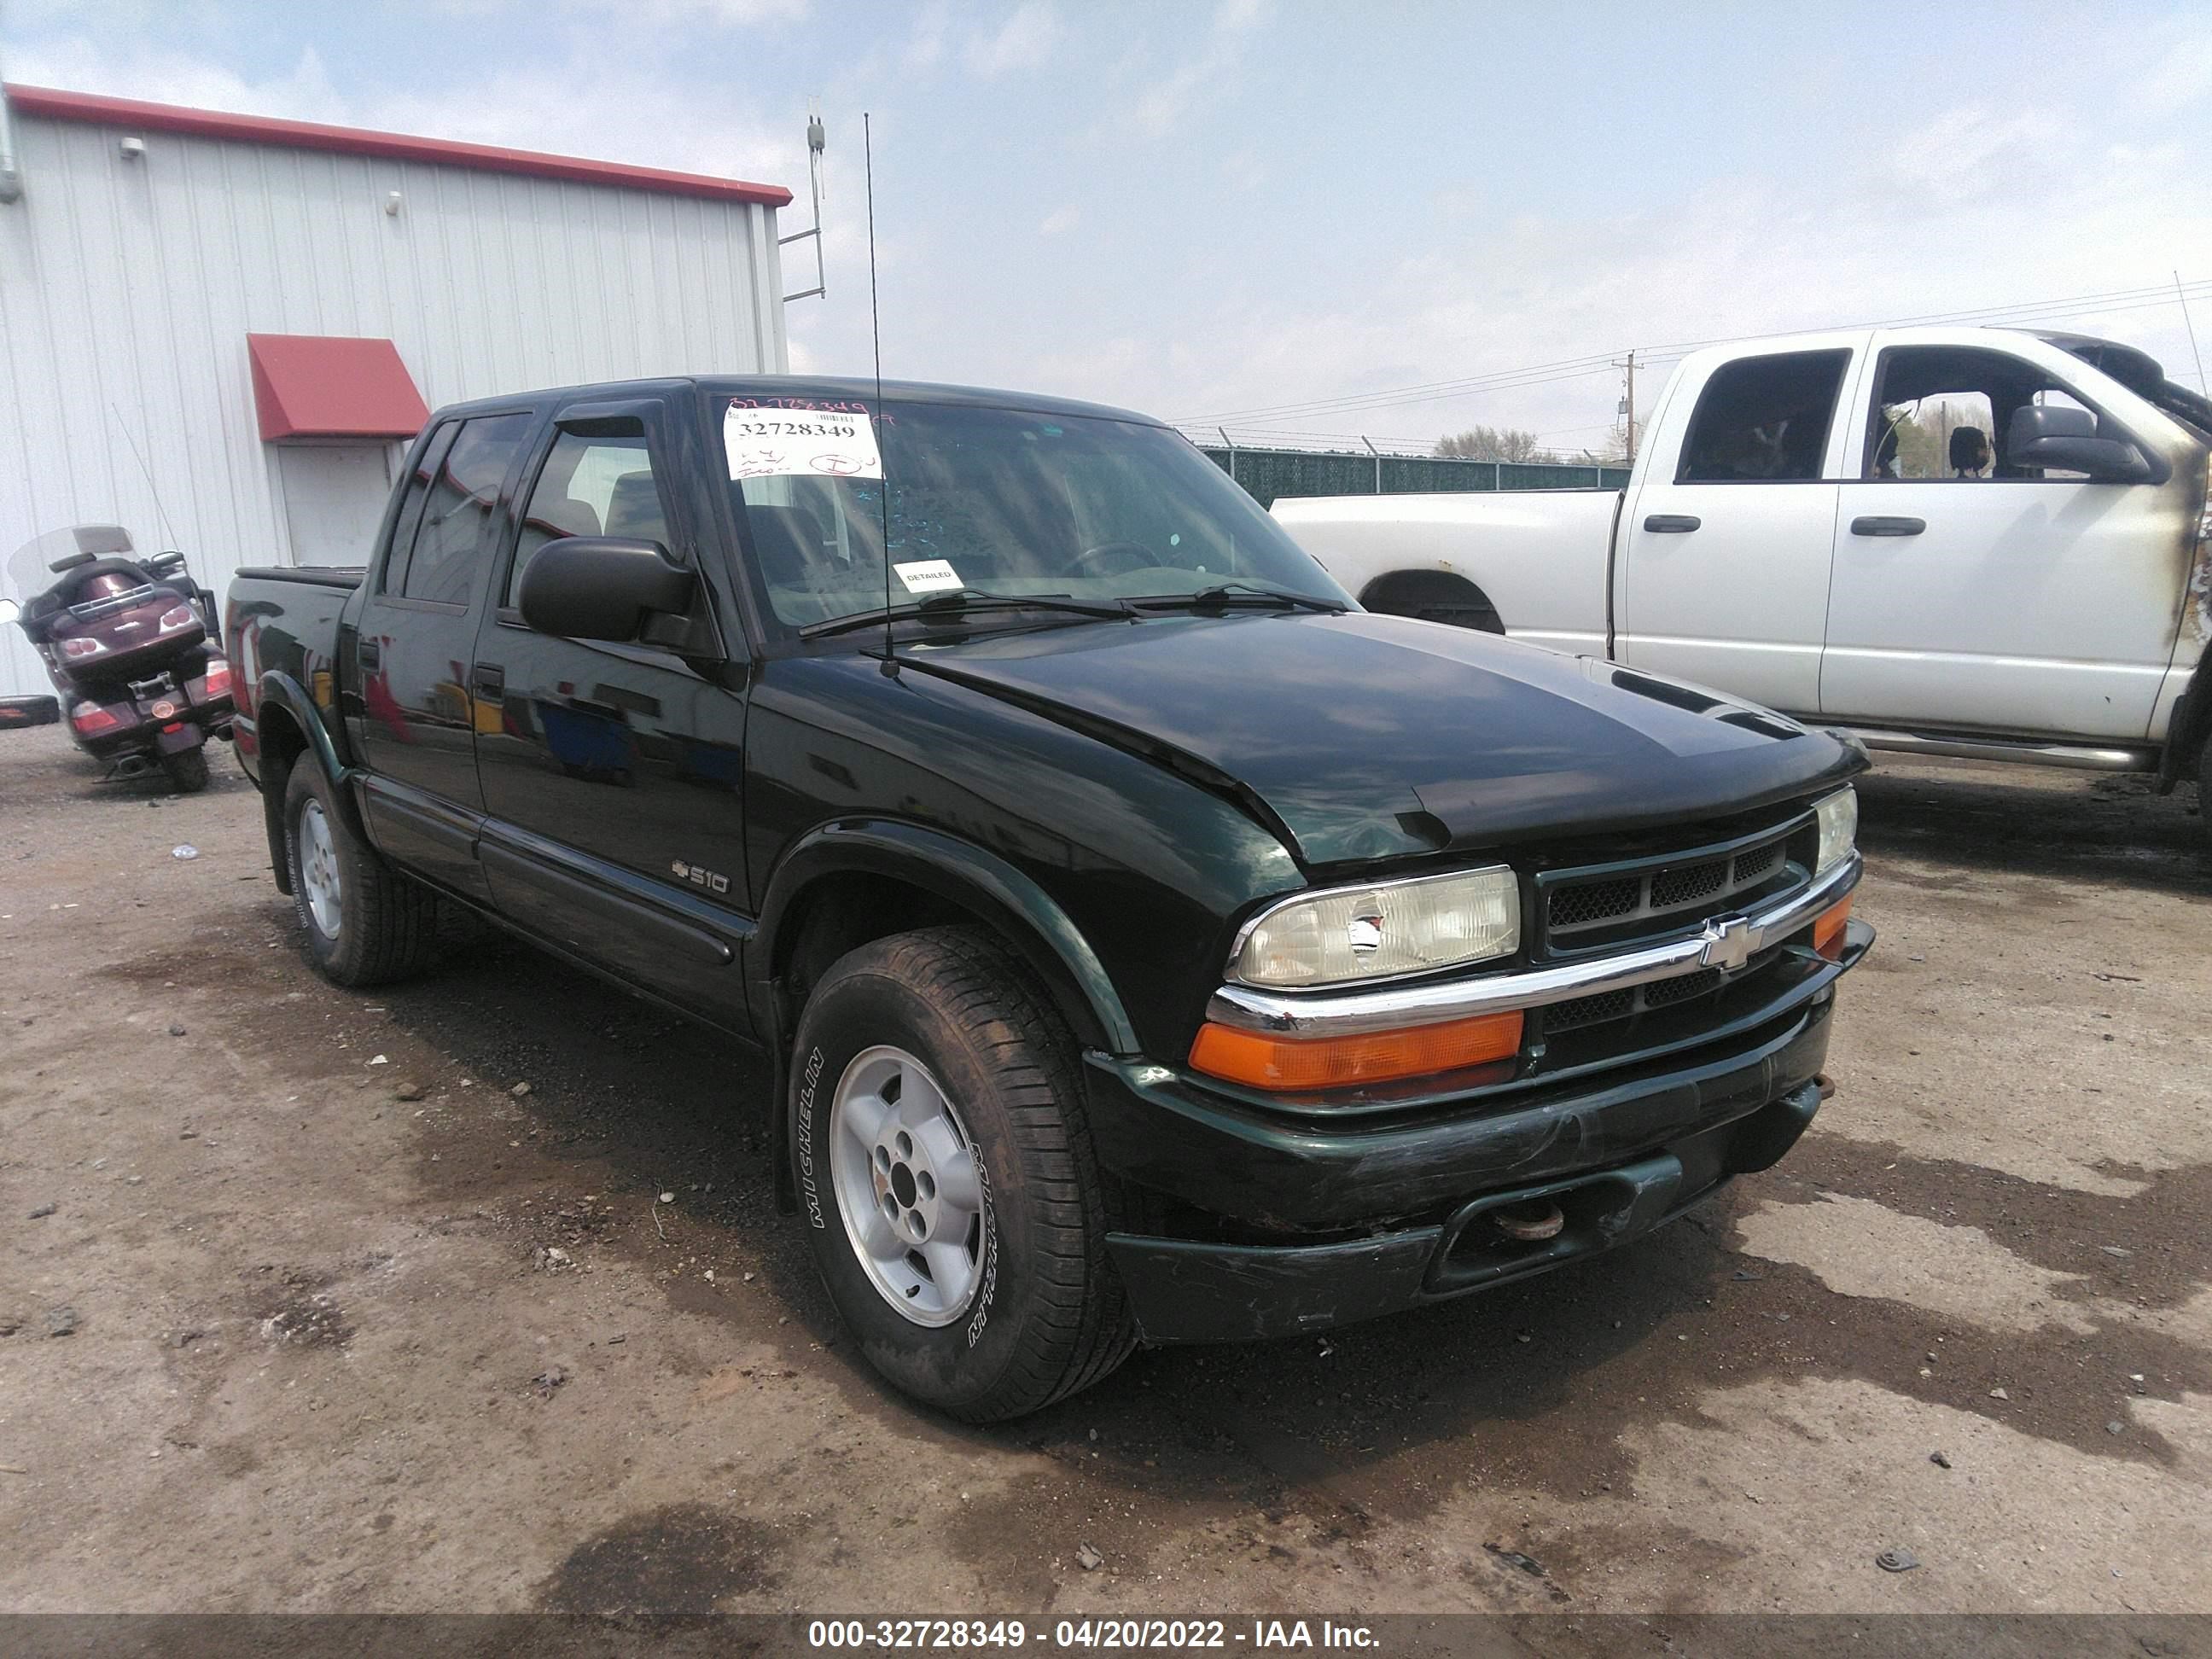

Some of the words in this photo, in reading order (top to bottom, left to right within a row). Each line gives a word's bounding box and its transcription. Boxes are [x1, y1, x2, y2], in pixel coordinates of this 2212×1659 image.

[738, 422, 856, 438] 32728349
[906, 571, 952, 581] DETAILED
[690, 865, 730, 894] S10
[798, 1046, 826, 1230] MICHELIN
[968, 1142, 999, 1349] MICHELIN
